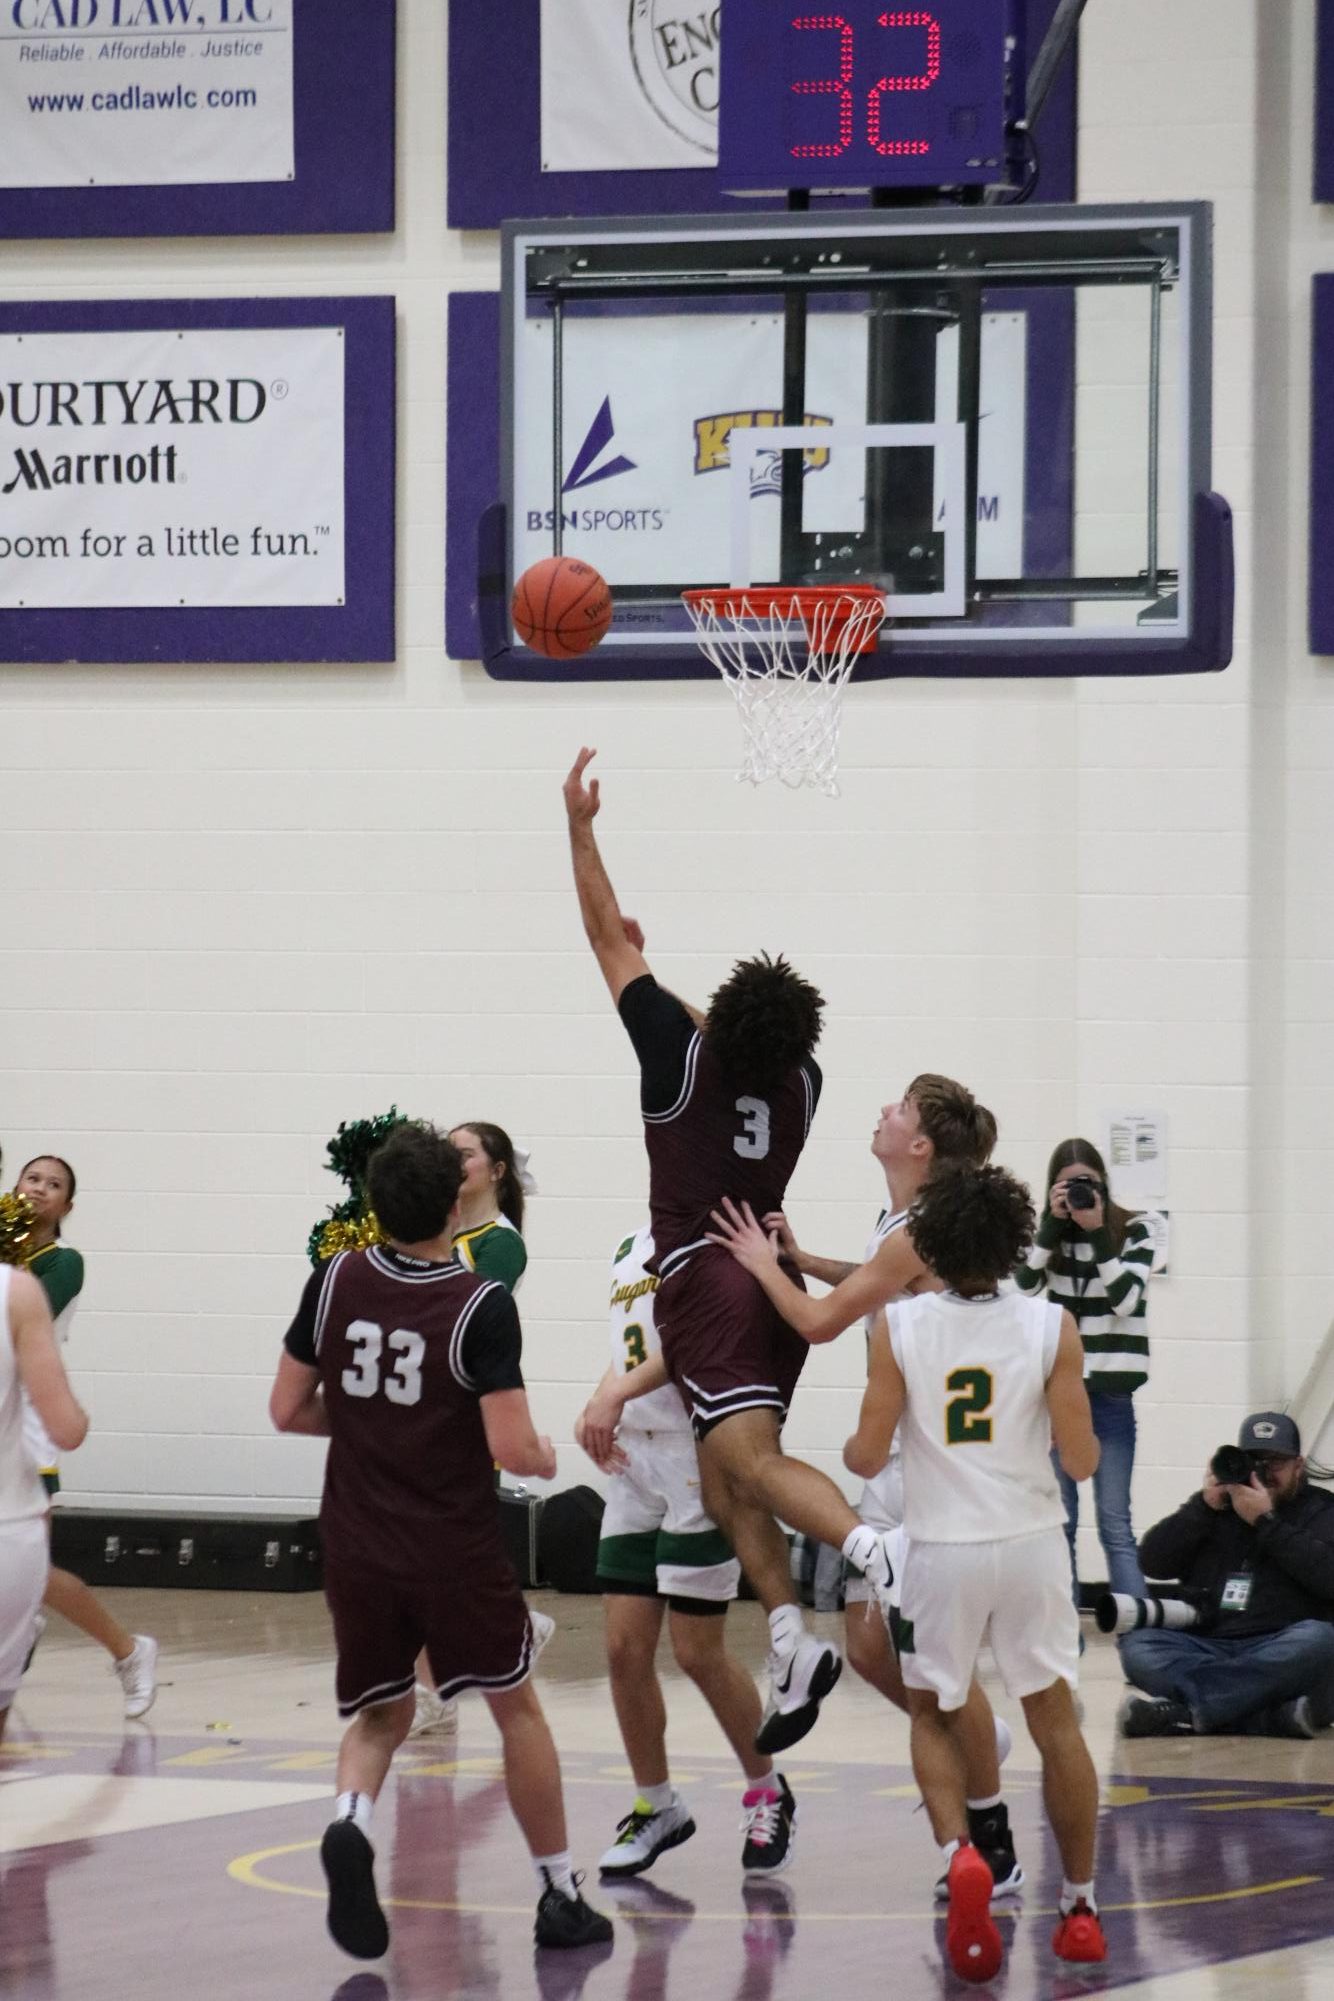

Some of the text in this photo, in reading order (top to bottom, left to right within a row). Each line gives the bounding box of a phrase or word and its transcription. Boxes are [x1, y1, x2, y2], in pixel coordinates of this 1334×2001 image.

[12, 0, 272, 29] CAD LAW, LC
[19, 40, 263, 62] Reliable Affordable Justice
[28, 85, 257, 112] www.cadlawlc.com
[791, 11, 940, 158] 32
[2, 445, 177, 494] Marriott
[80, 528, 126, 557] for
[136, 538, 155, 556] a
[165, 528, 239, 556] little
[733, 1095, 770, 1160] 3
[341, 1319, 426, 1407] 33
[945, 1366, 993, 1446] 2
